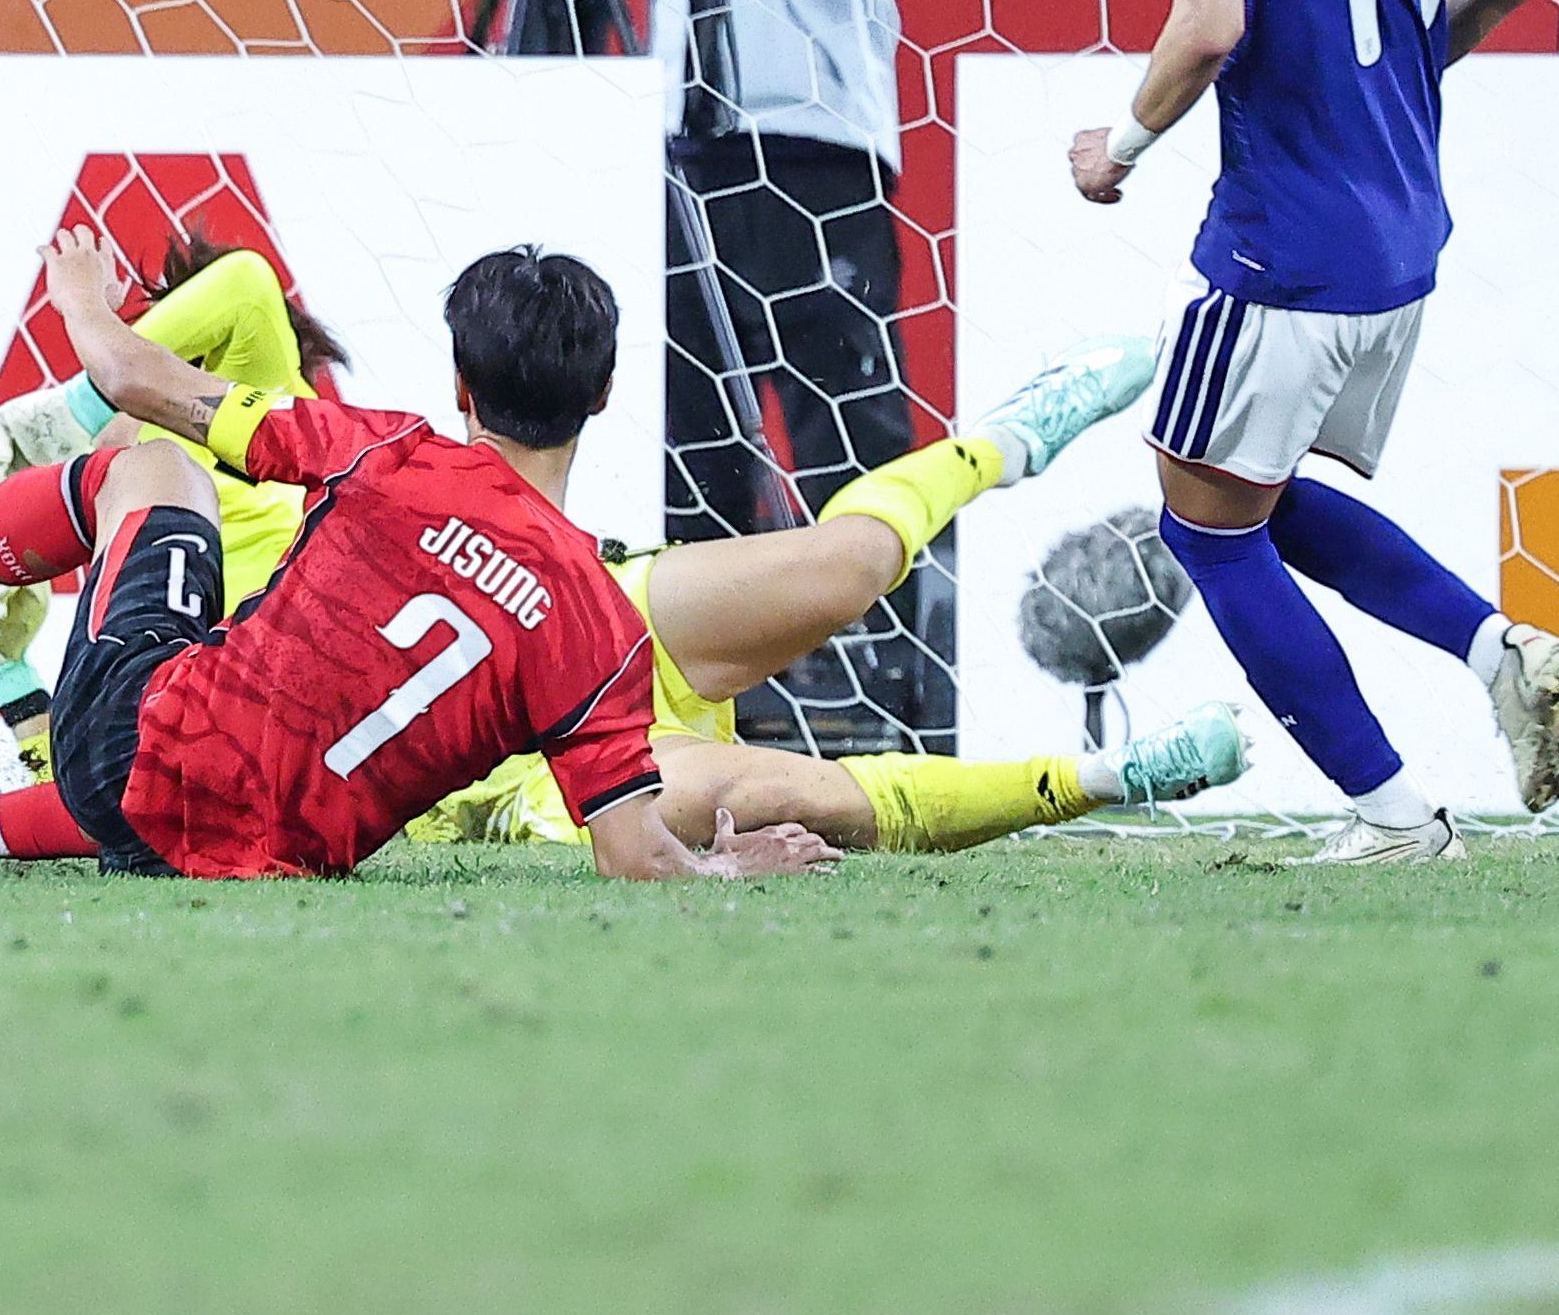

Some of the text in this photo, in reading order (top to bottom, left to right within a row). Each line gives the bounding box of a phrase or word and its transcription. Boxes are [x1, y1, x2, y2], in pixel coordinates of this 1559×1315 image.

[166, 546, 204, 619] 7
[420, 516, 552, 631] JISUNG
[324, 593, 493, 781] 7
